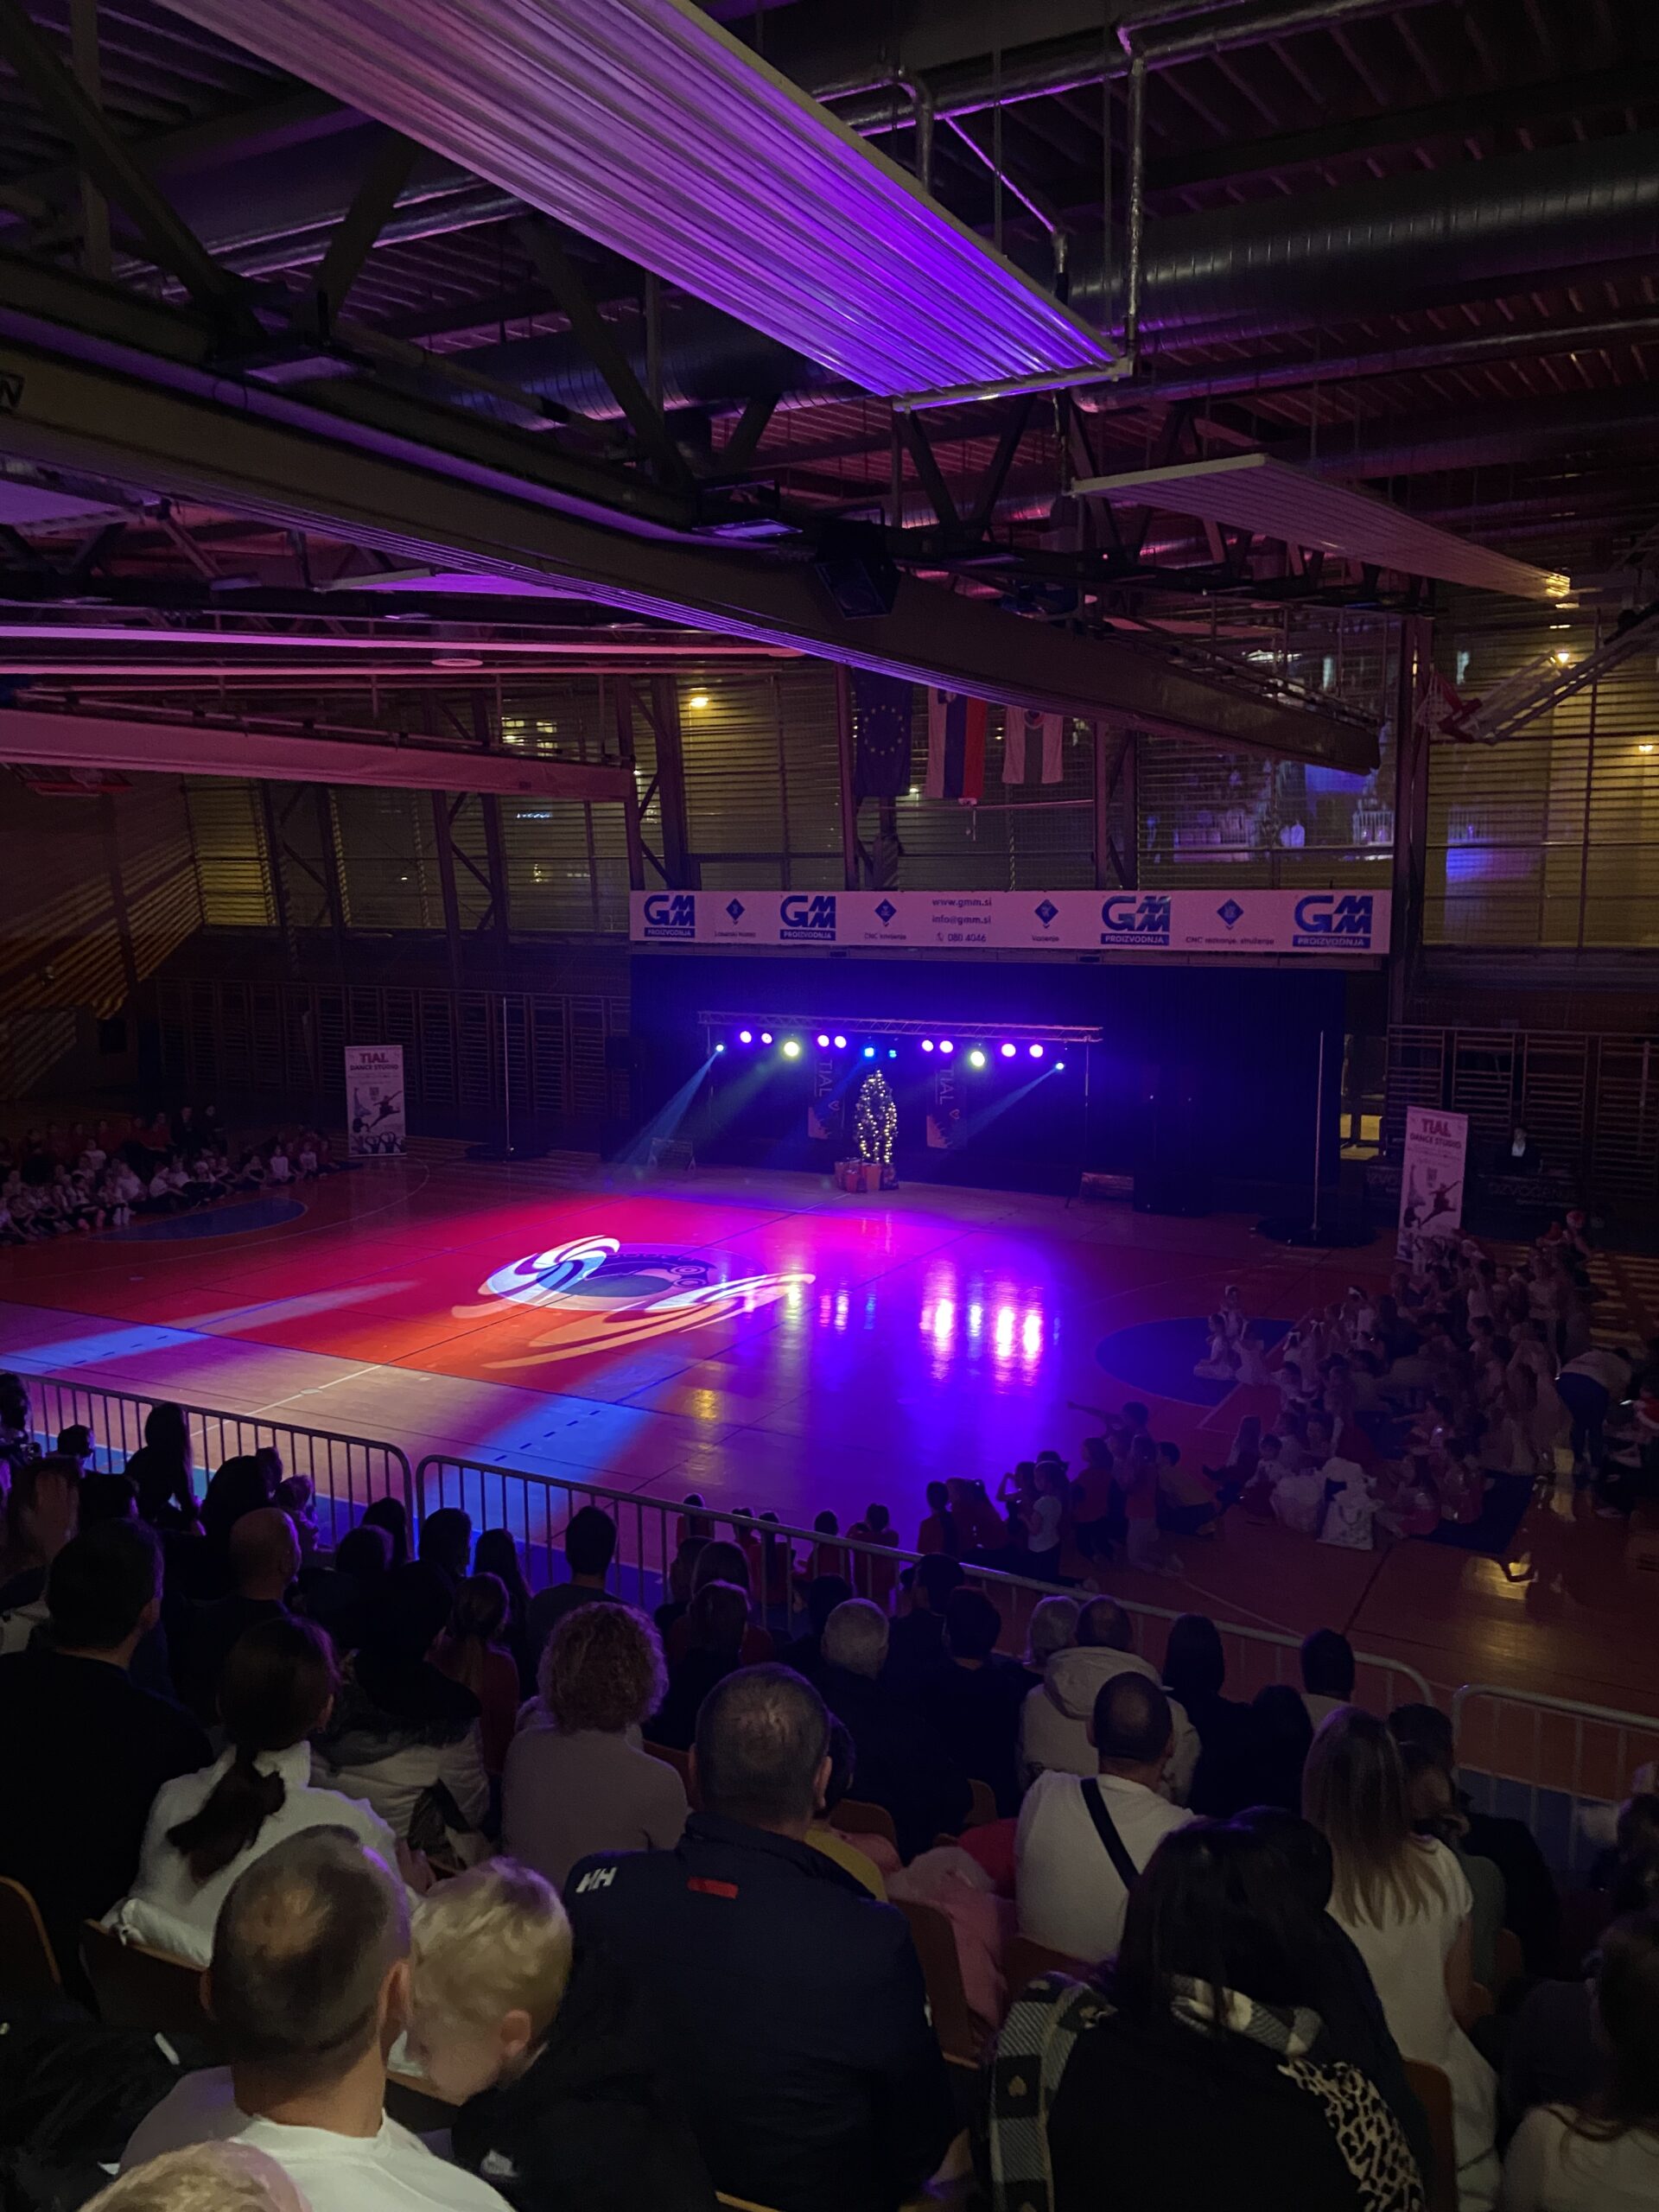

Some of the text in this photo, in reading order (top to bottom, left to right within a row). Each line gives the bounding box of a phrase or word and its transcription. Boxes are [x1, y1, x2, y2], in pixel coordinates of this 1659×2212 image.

[931, 897, 992, 907] www.gmm.si
[783, 931, 831, 939] PROIZVODNJA
[948, 933, 963, 942] 080
[1105, 935, 1165, 944] PROIZVODNJA
[1298, 938, 1364, 946] PROIZVODNJA
[359, 1052, 389, 1063] TIAL
[1422, 1118, 1452, 1137] TIAL
